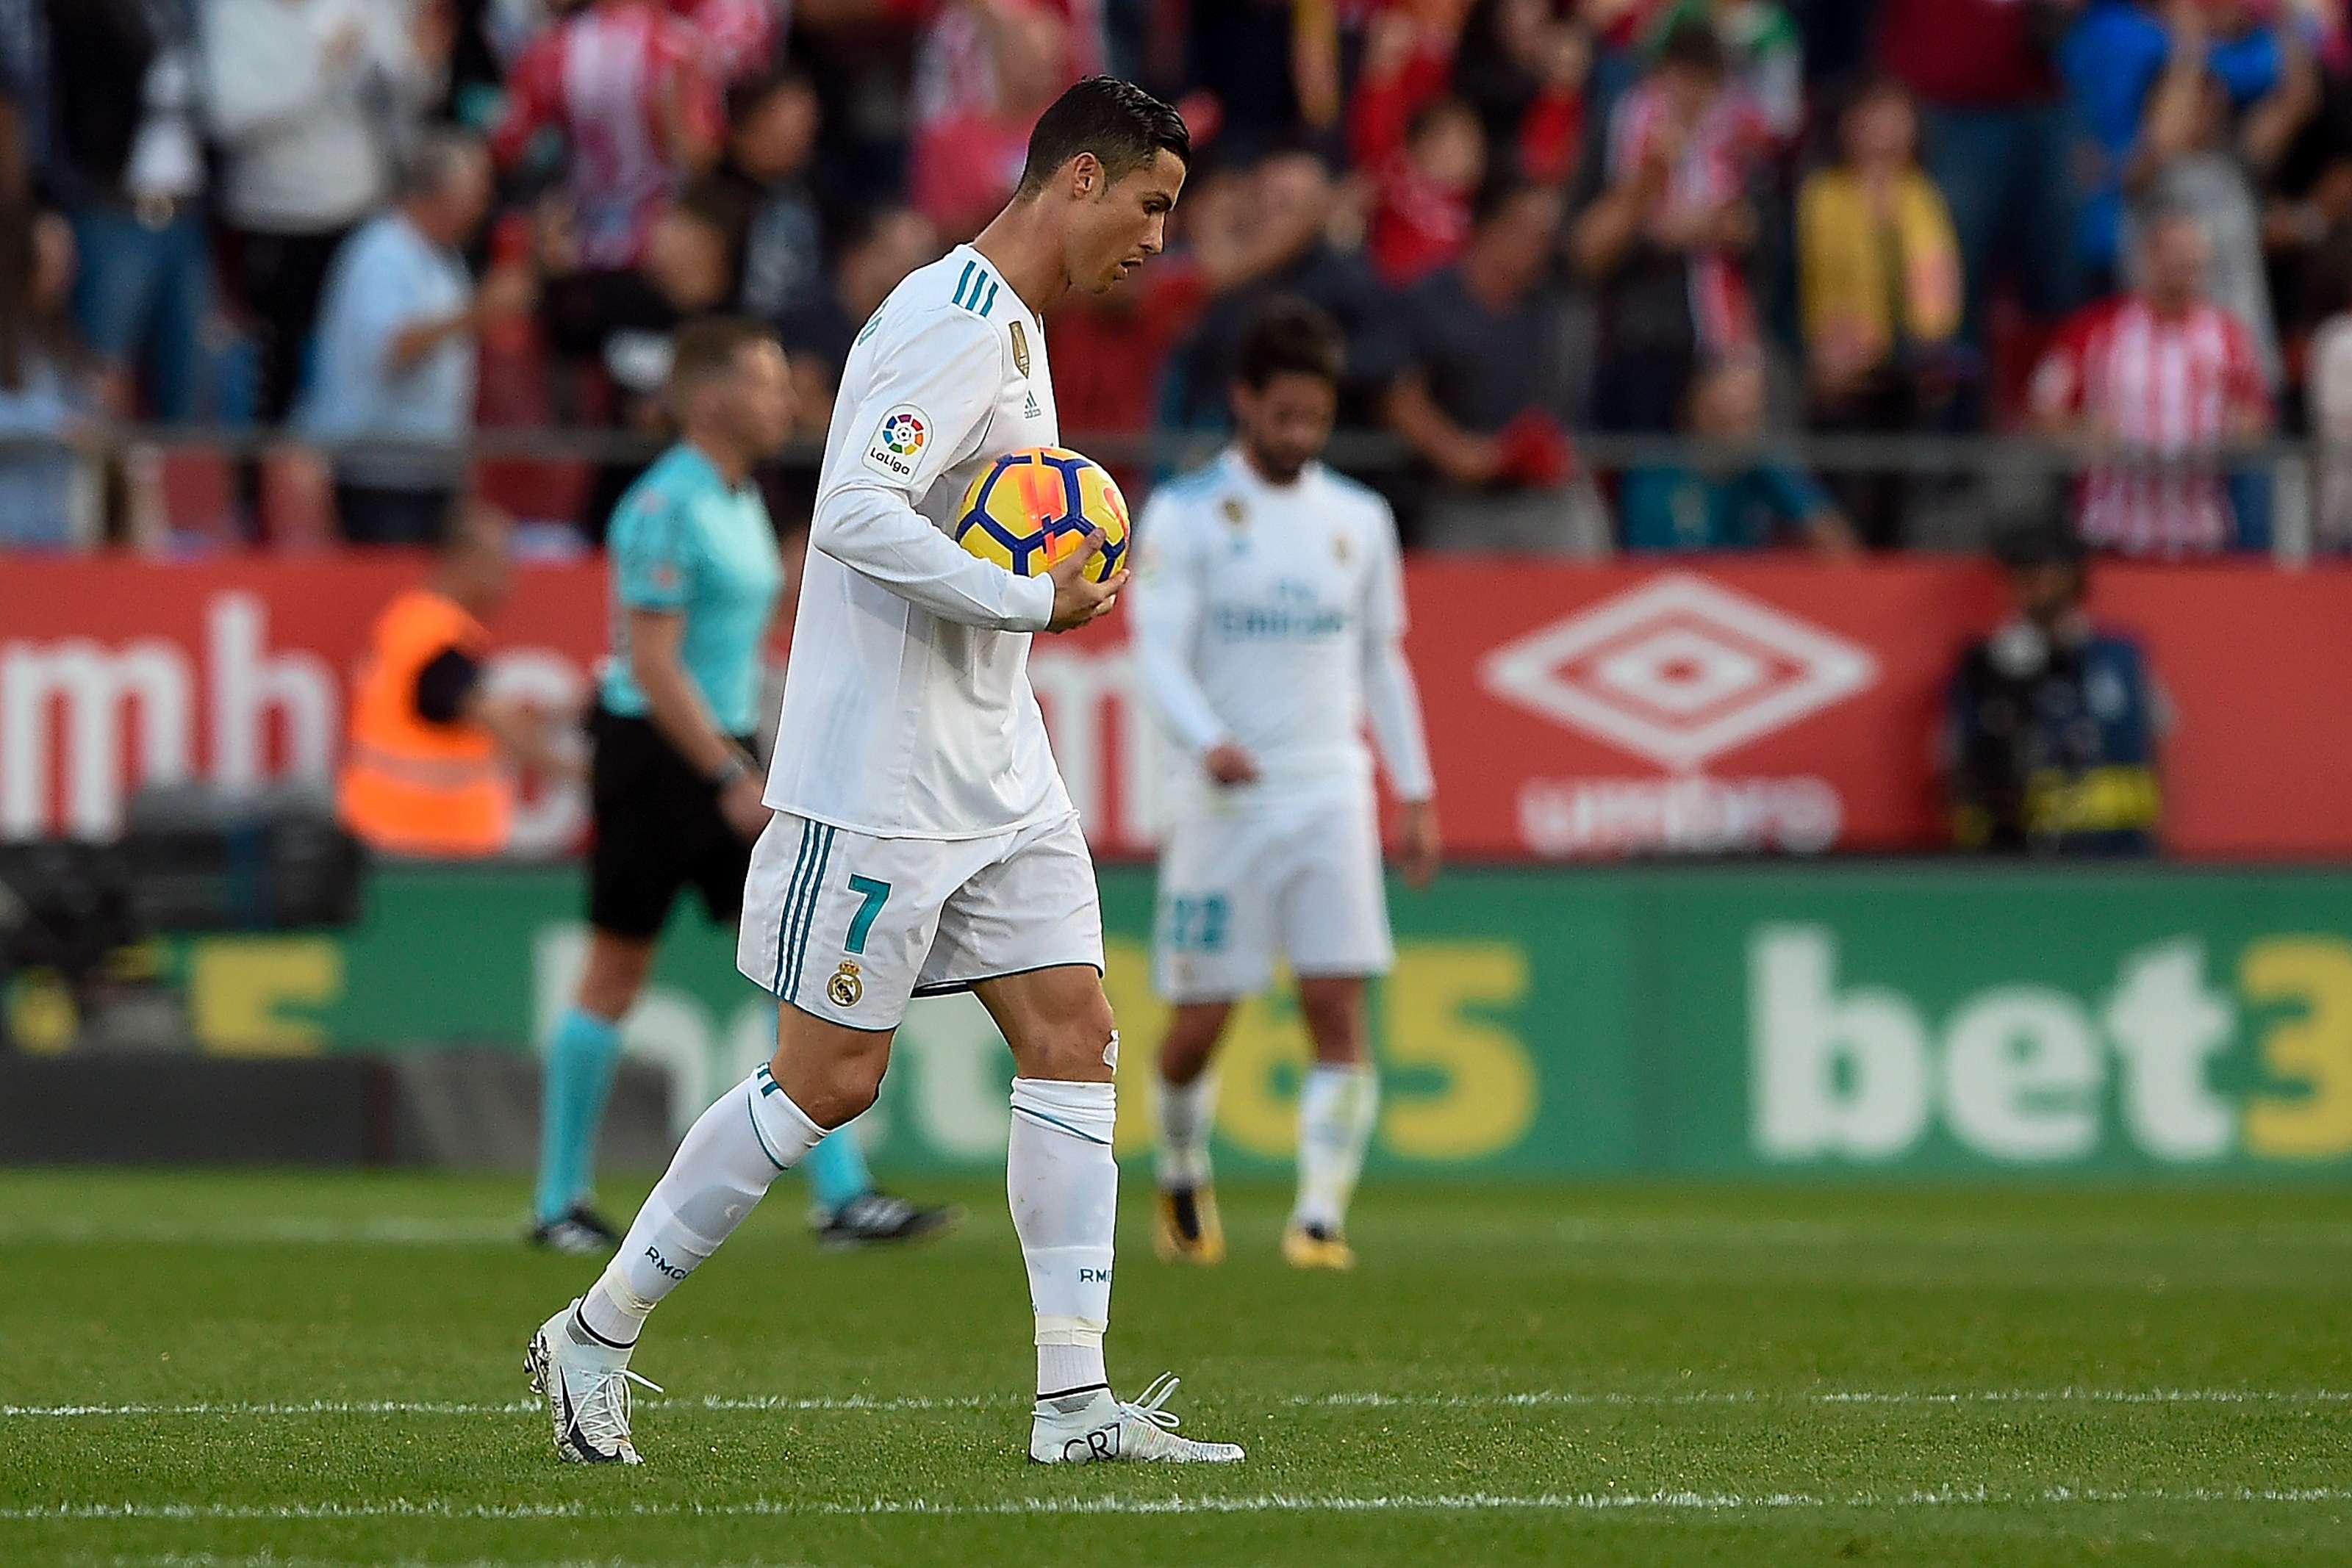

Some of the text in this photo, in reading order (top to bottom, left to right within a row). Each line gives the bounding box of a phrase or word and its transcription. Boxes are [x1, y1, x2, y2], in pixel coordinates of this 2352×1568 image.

[870, 447, 911, 475] LaLiga
[845, 874, 892, 955] 7
[1749, 922, 2352, 1162] bet3
[1063, 1422, 1122, 1464] CR7
